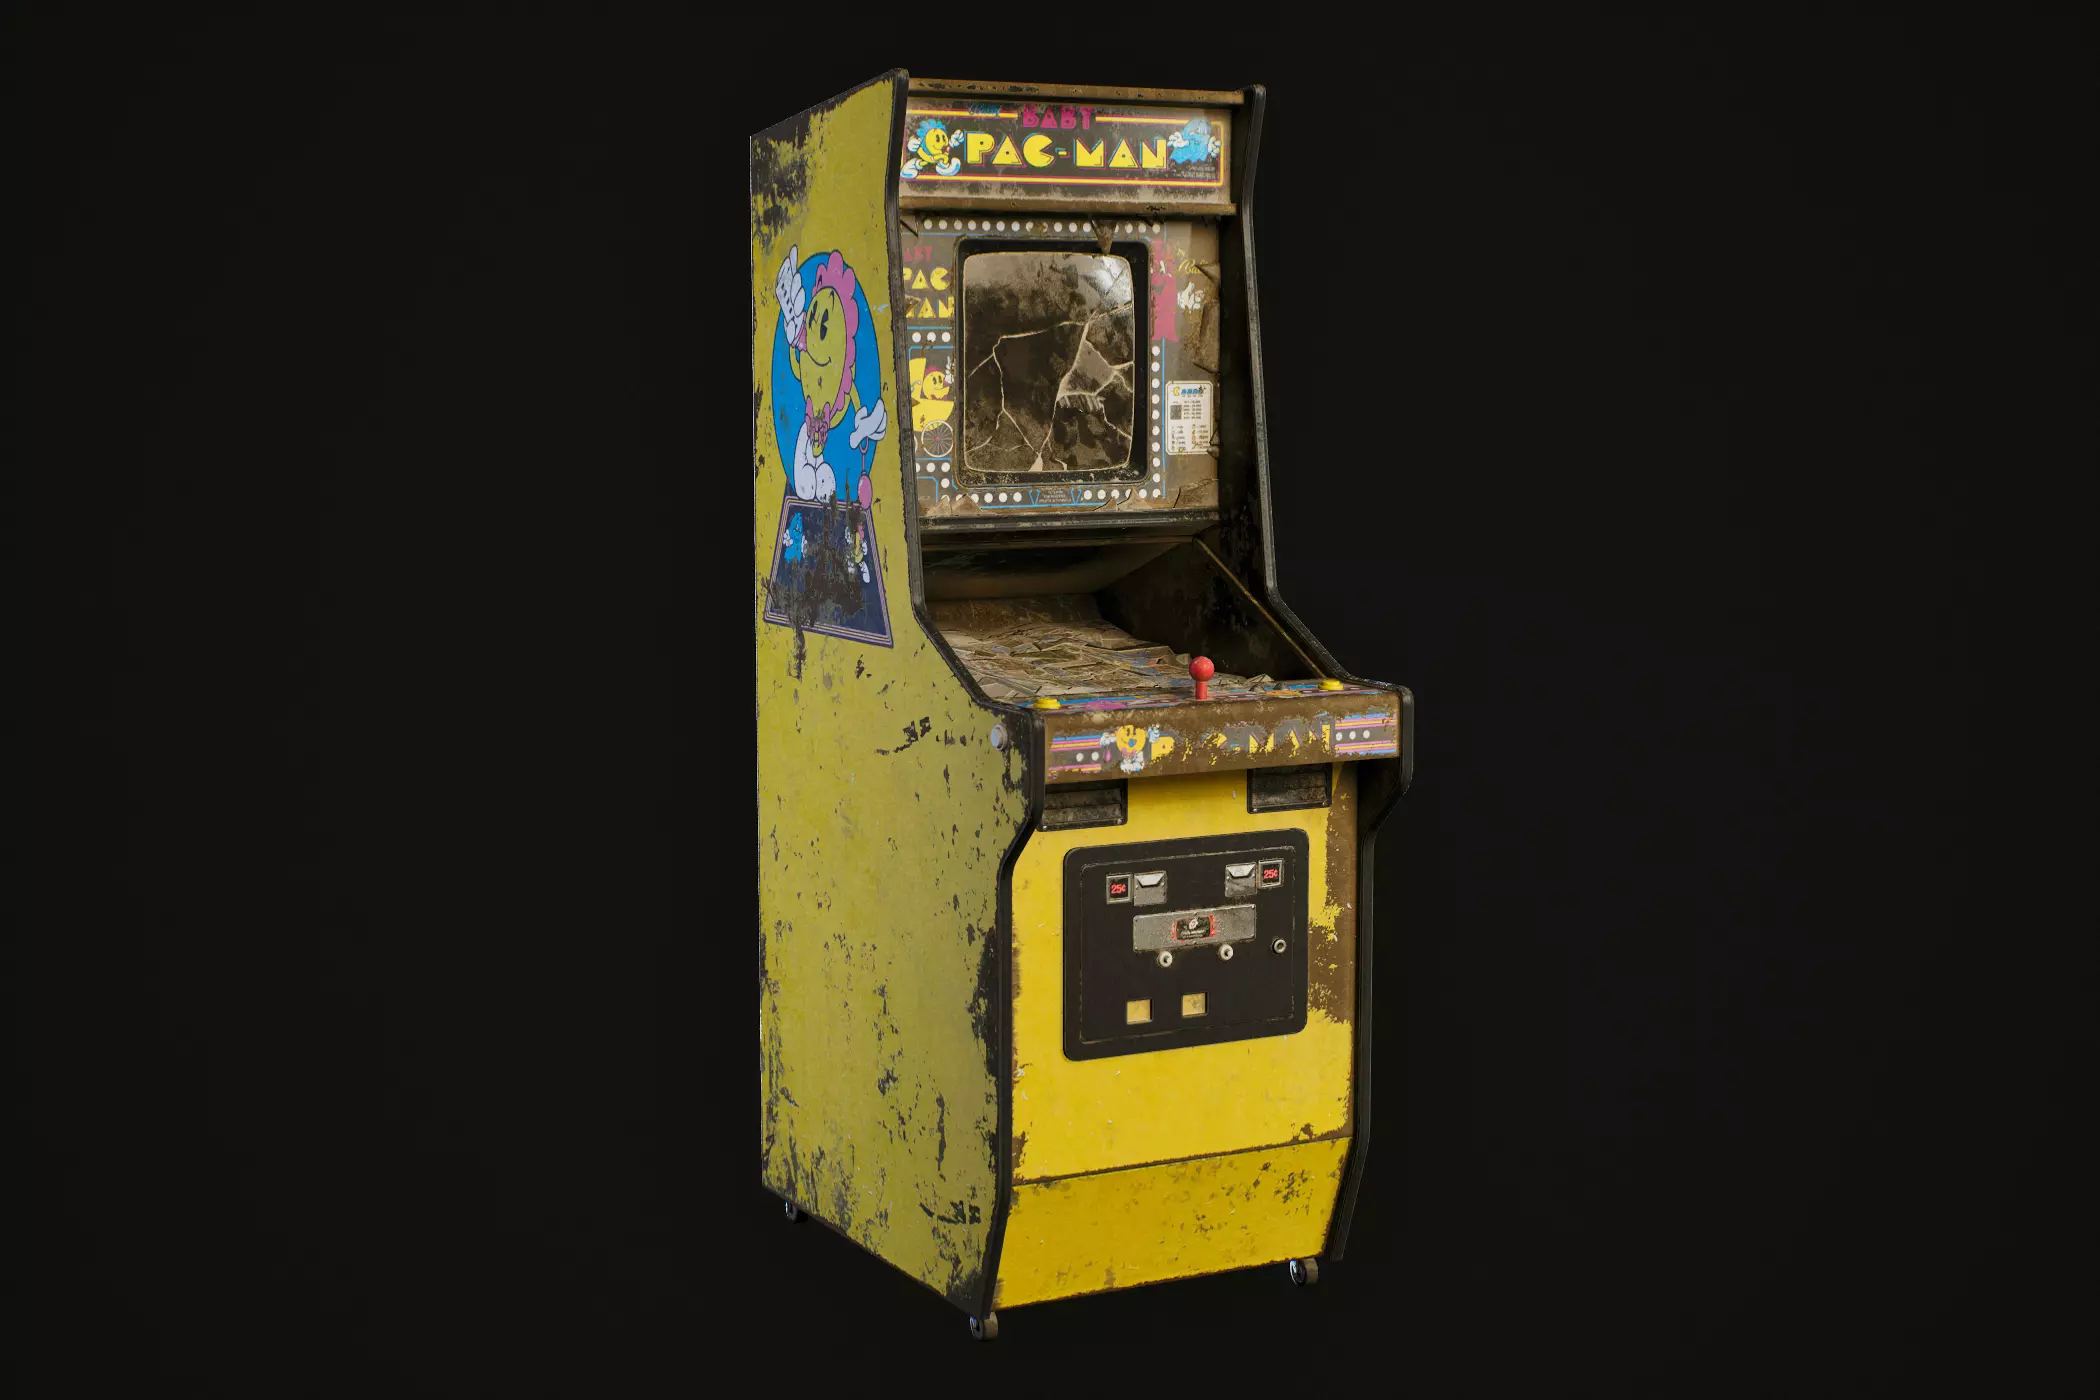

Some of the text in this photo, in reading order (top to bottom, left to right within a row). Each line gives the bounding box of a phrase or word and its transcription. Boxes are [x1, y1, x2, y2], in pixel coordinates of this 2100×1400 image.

[1022, 103, 1094, 130] BABY
[964, 131, 1168, 171] PAC-MAN
[903, 246, 933, 262] ABY
[902, 267, 950, 291] PAC
[1263, 868, 1279, 880] 25¢
[1111, 883, 1126, 895] 25¢
